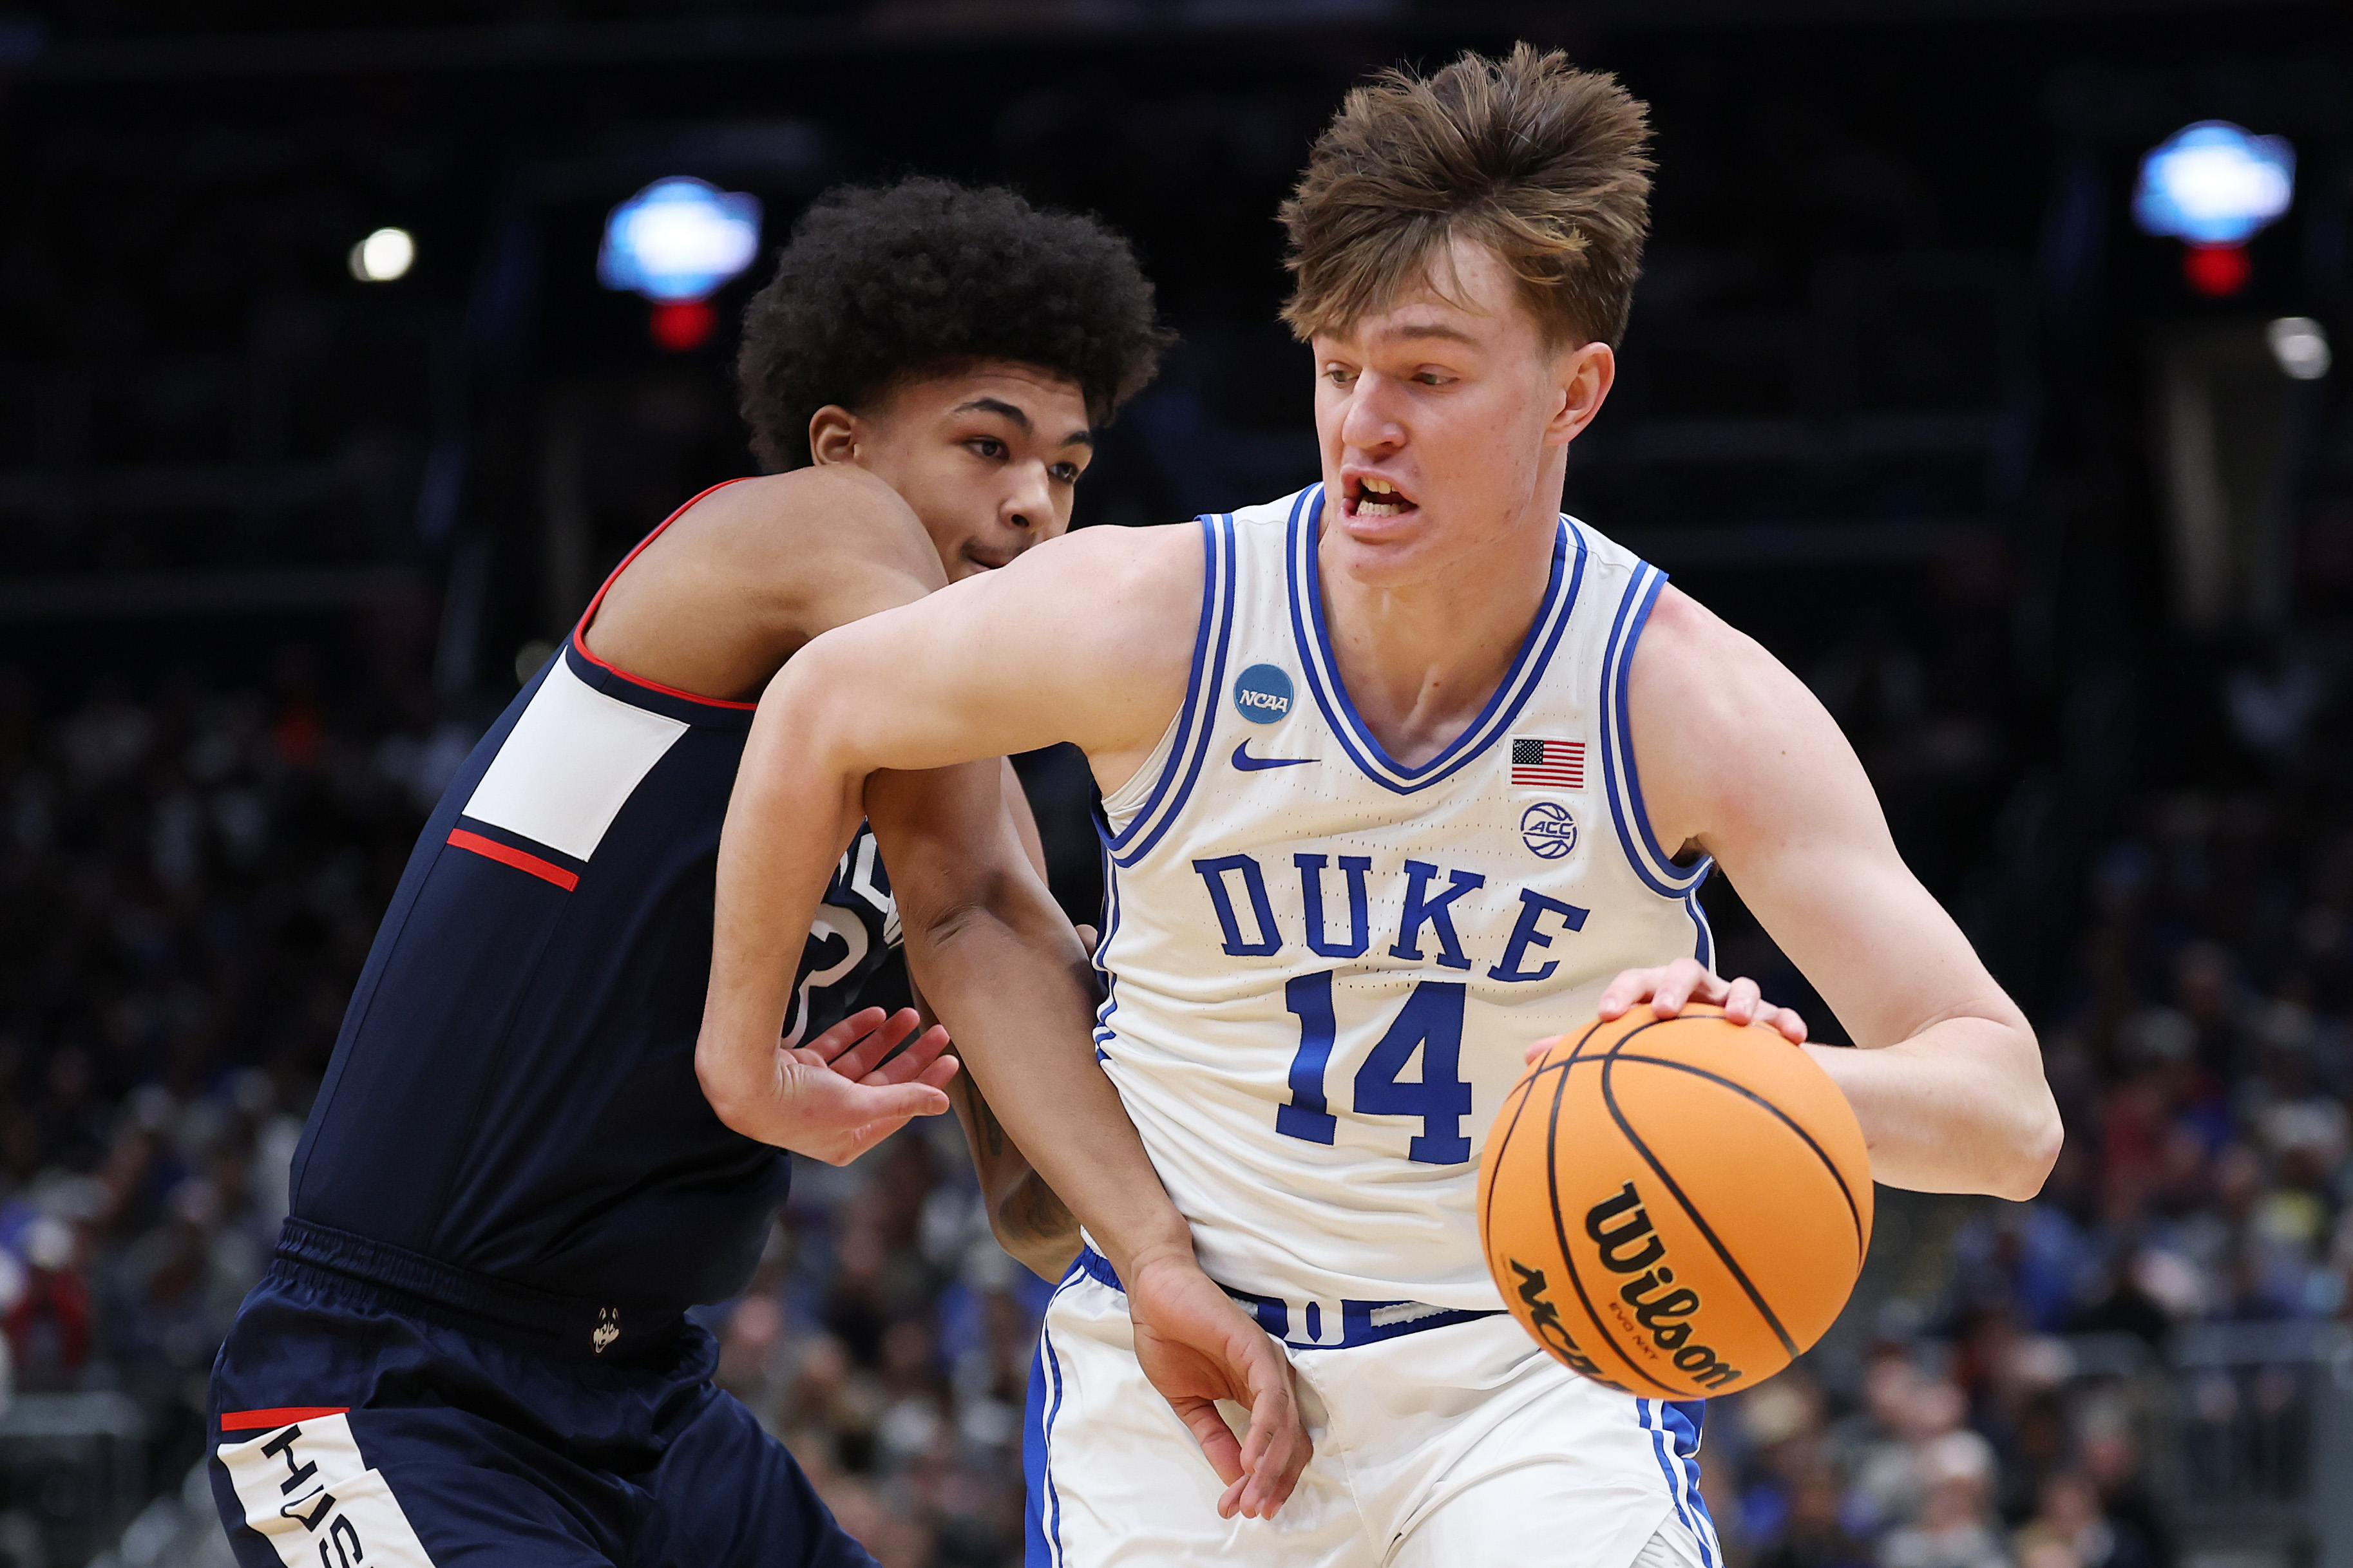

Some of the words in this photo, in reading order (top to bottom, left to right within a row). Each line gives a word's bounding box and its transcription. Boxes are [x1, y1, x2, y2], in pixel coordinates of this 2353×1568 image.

[1239, 688, 1288, 713] NCAA
[1528, 820, 1574, 835] ACC
[1192, 853, 1590, 983] DUKE
[1276, 969, 1472, 1165] 14
[1585, 1179, 1742, 1390] Wilson
[1609, 1301, 1635, 1332] EVO
[1632, 1334, 1659, 1361] NXT
